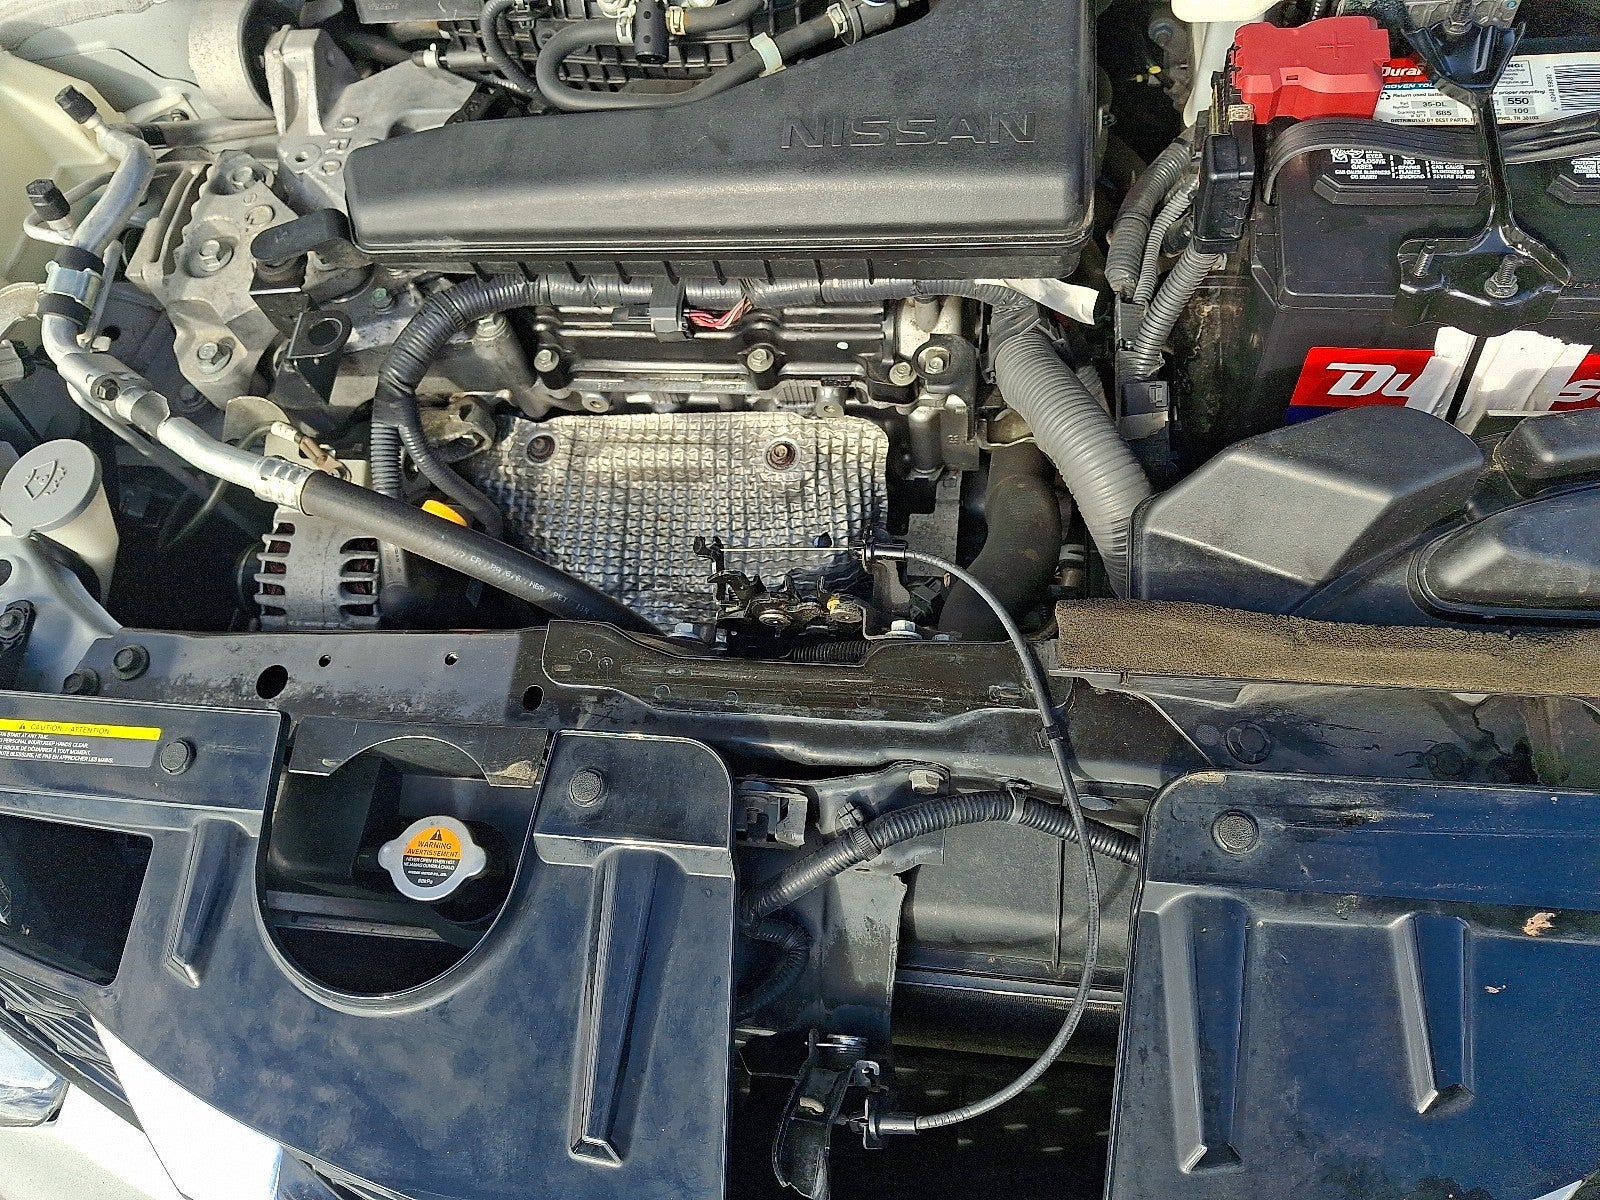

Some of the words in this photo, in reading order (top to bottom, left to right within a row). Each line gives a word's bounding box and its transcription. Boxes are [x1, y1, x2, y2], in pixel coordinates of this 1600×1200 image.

[1507, 97, 1530, 105] 550
[780, 111, 1036, 150] NISSAN
[30, 723, 63, 733] CAUTION
[70, 726, 111, 735] ATTENTION
[58, 754, 88, 762] APPROCHER
[418, 840, 452, 850] WARNING
[406, 848, 459, 858] AVERTISSEMENT
